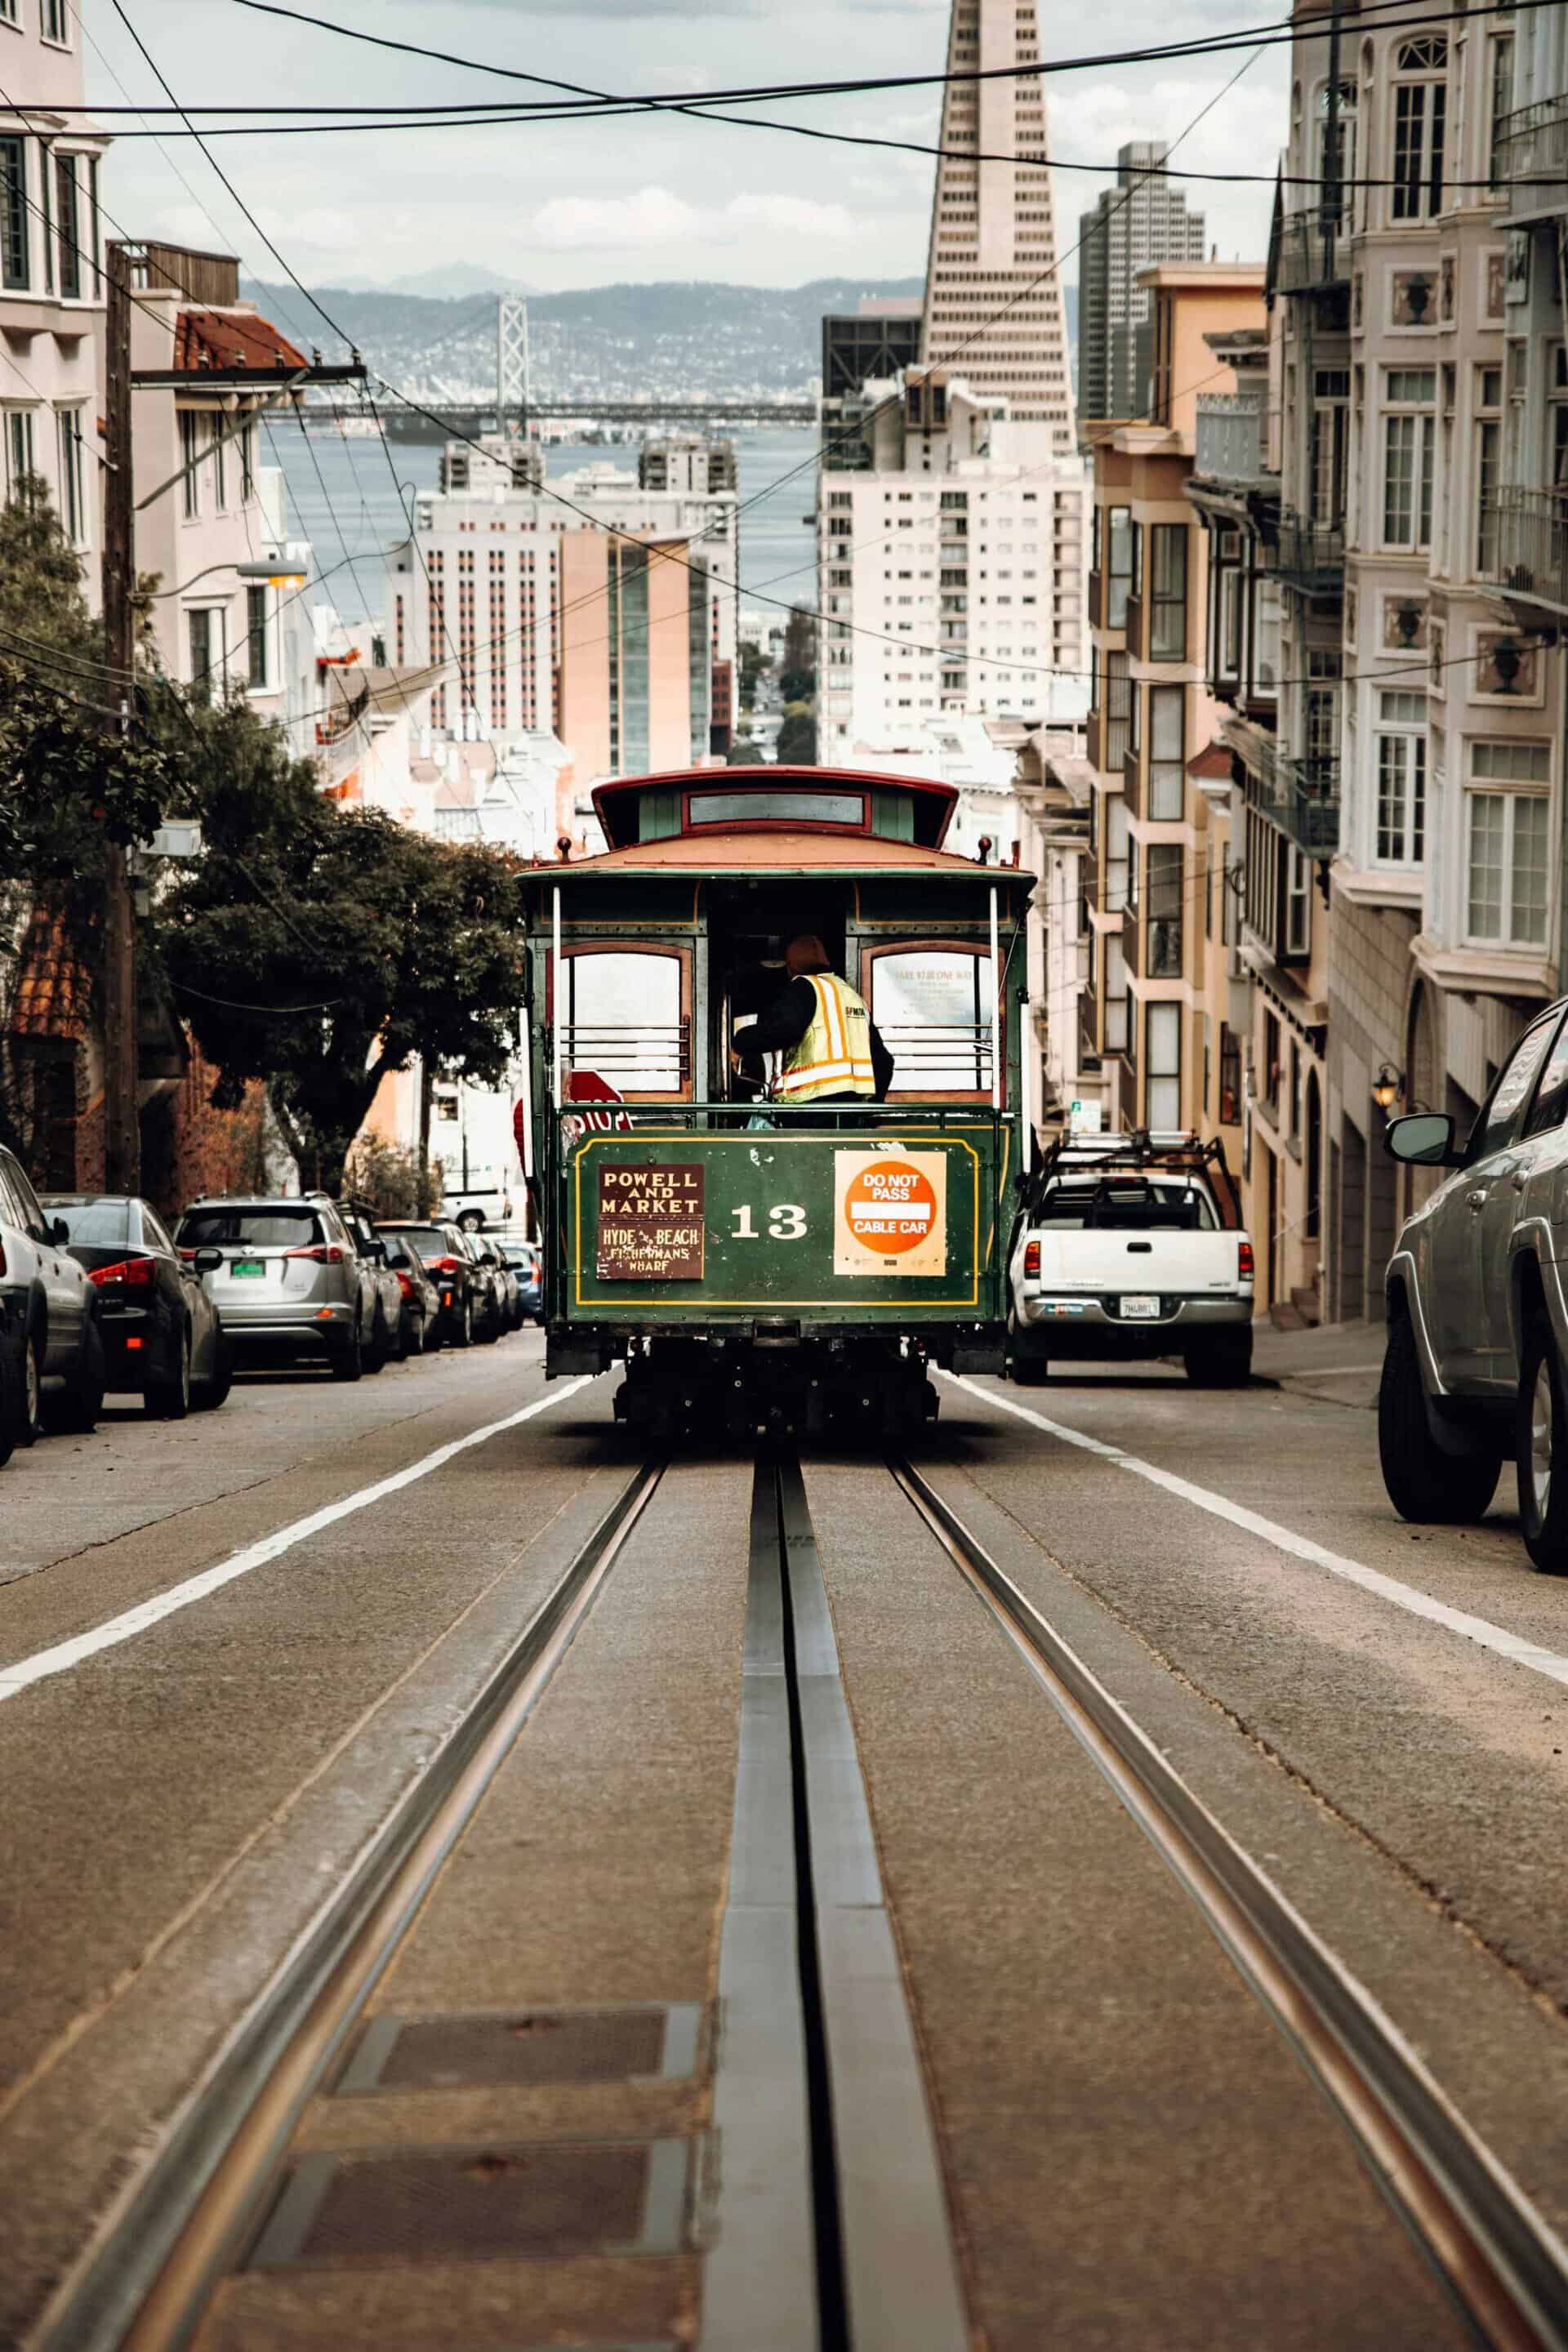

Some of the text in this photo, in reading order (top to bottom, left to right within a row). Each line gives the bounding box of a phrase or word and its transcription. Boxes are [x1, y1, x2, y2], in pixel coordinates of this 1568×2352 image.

[604, 1172, 697, 1187] POWELL
[863, 1174, 920, 1187] DO NOT
[628, 1187, 674, 1198] AND
[872, 1187, 911, 1200] PASS
[601, 1199, 699, 1214] MARKET
[731, 1204, 808, 1240] 13
[853, 1221, 928, 1234] CABLE CAR
[603, 1229, 636, 1245] HYDE
[656, 1229, 698, 1245] BEACH
[628, 1260, 670, 1272] WHARF
